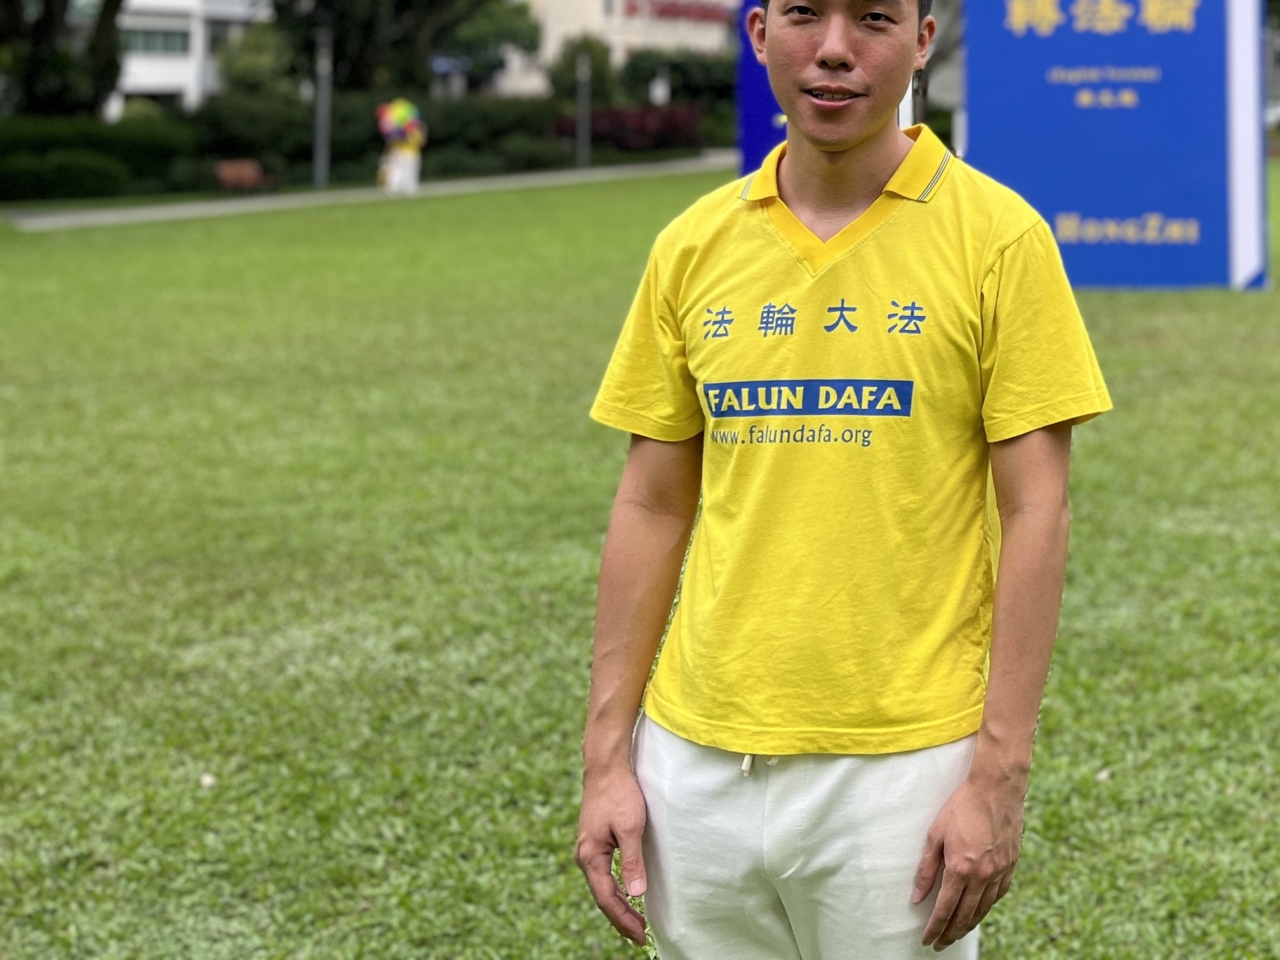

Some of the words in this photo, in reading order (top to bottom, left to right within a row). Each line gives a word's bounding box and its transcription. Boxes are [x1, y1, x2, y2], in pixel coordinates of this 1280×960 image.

[703, 298, 926, 340] 法輪大法
[708, 386, 804, 412] FALUN
[817, 385, 902, 410] DAFA
[710, 423, 872, 447] www.falundafa.org
